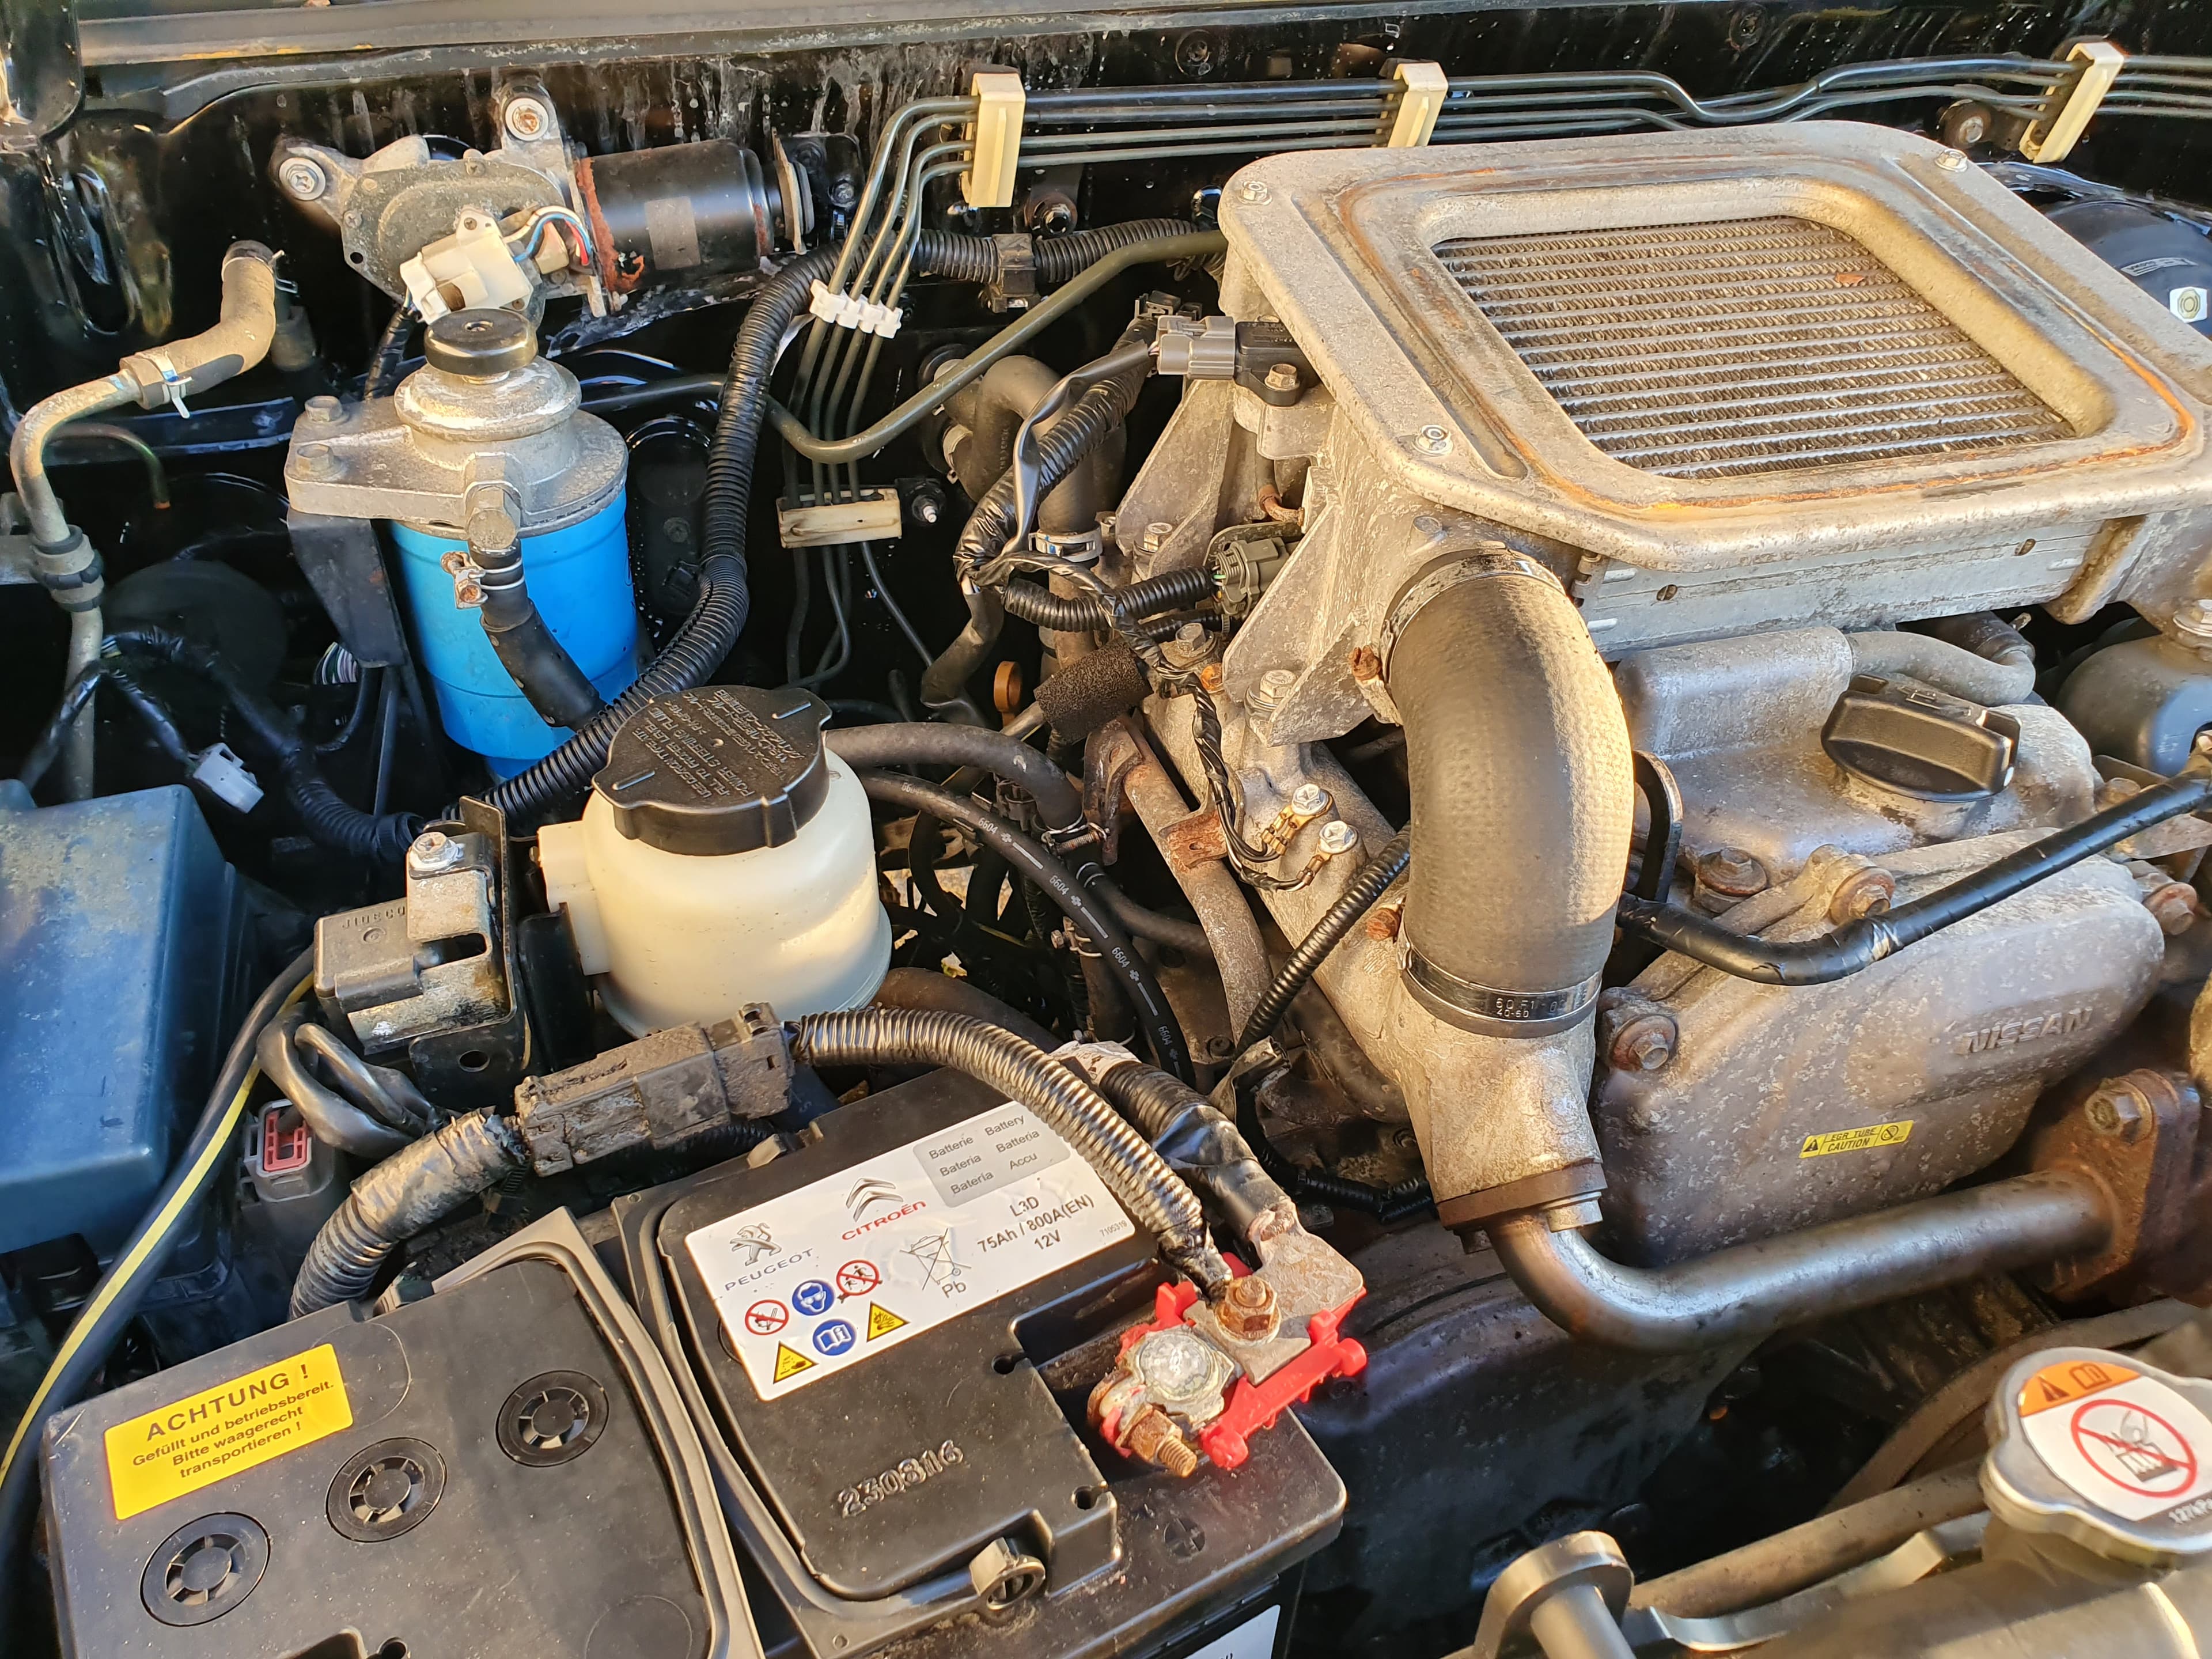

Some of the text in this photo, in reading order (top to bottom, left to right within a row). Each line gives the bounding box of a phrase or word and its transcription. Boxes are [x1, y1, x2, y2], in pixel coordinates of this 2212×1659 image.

[648, 707, 755, 797] POWER STEERING FLUID
[665, 741, 699, 770] PROPER
[695, 768, 711, 780] TO
[691, 779, 713, 798] USE
[979, 817, 998, 835] 6604
[1049, 875, 1069, 896] 6604
[1111, 946, 1131, 968] 6604
[1157, 1025, 1173, 1046] 6604
[1955, 1007, 2093, 1055] NISSAN
[928, 1114, 1025, 1160] Batterie Battery
[1827, 1138, 1870, 1152] CAUTION
[1831, 1128, 1877, 1141] EGR TUBE
[939, 1128, 1040, 1177] Bateria Batteria
[1009, 1152, 1038, 1171] Accu
[1009, 1196, 1040, 1217] L3D
[977, 1194, 1095, 1253] 75Ah / 800A(EN)
[1034, 1229, 1062, 1251] 12V
[724, 1248, 814, 1291] PEUGEOT
[942, 1281, 967, 1298] Pb
[146, 1363, 309, 1441] ACHTUNG !
[132, 1380, 335, 1467] Gefüllt und betriebsbereit.
[172, 1406, 304, 1467] Bitte waagerecht
[180, 1421, 302, 1479] transportieren !
